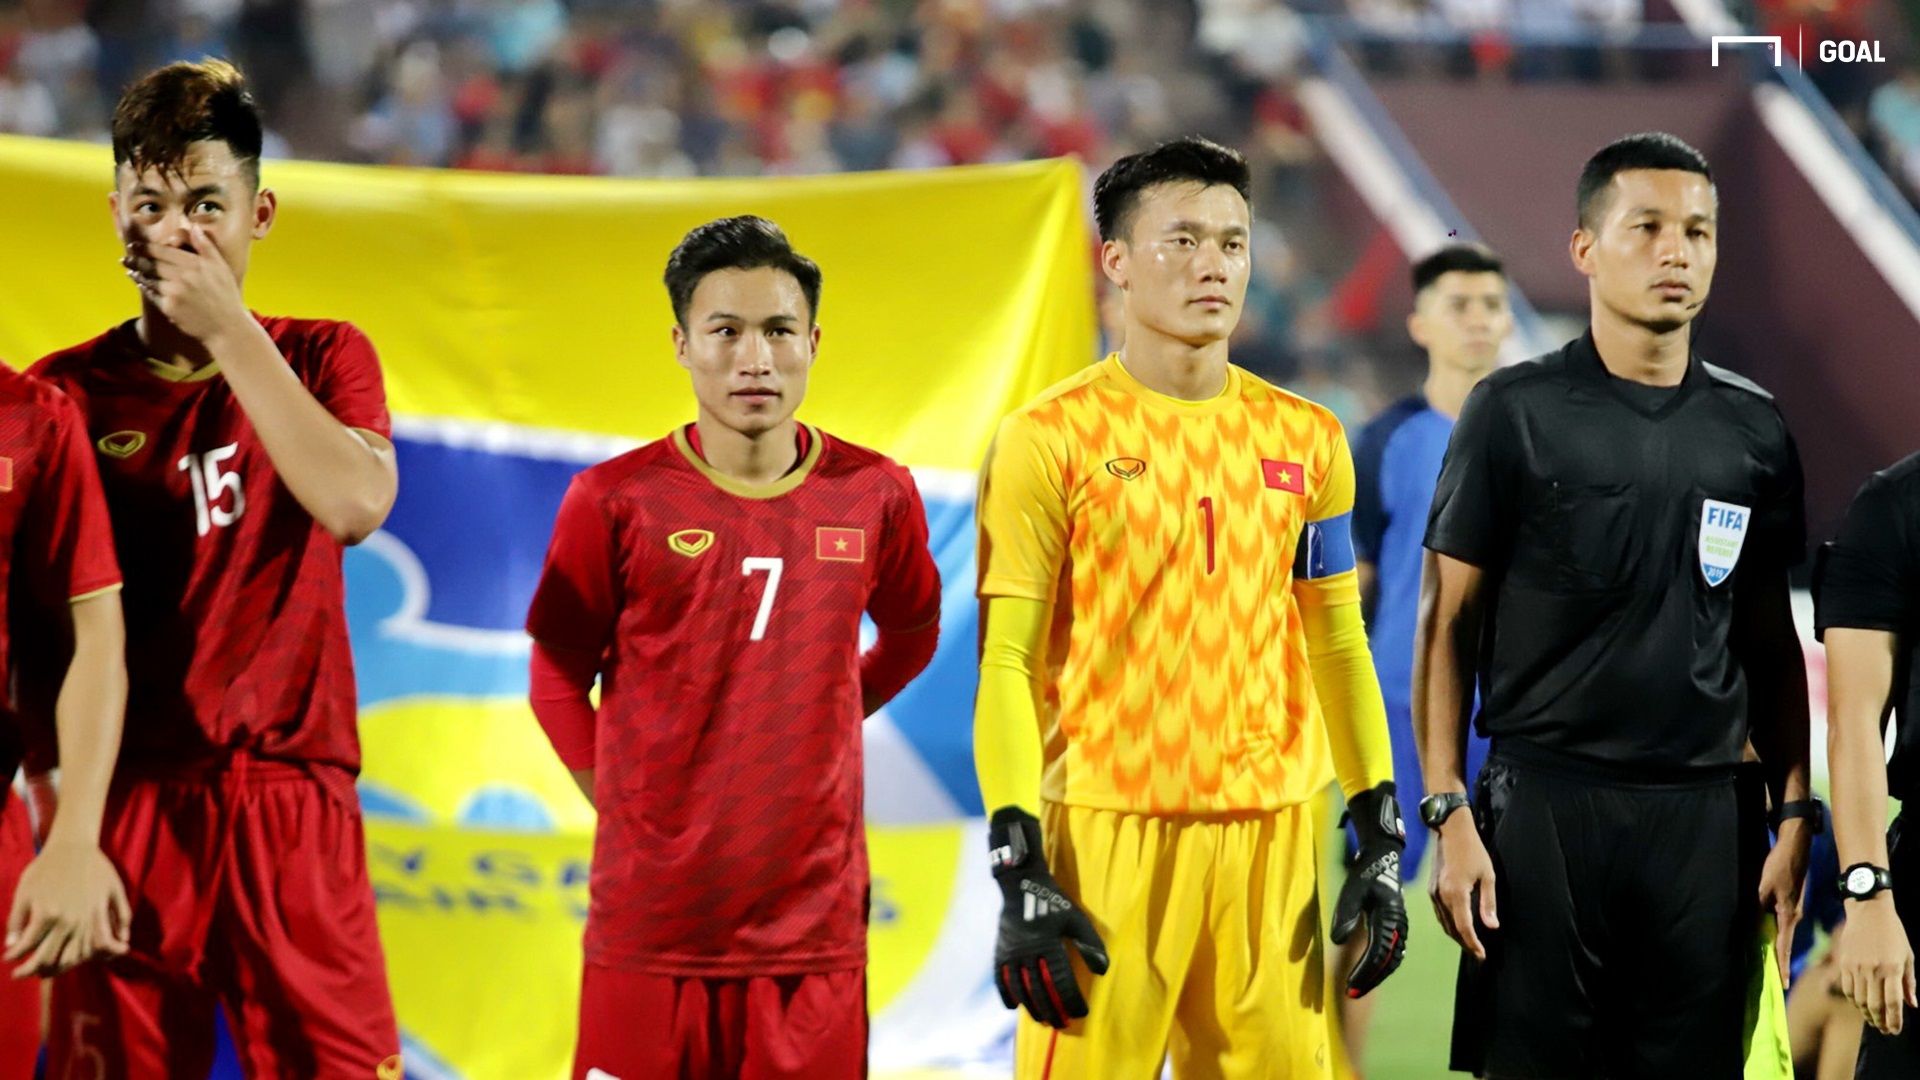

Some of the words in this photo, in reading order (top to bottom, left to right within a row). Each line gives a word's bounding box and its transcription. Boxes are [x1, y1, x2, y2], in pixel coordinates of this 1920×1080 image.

[178, 440, 246, 537] 15
[1707, 507, 1744, 531] FIFA
[1198, 496, 1215, 575] 1
[742, 556, 784, 641] 7
[1020, 879, 1072, 910] adidas
